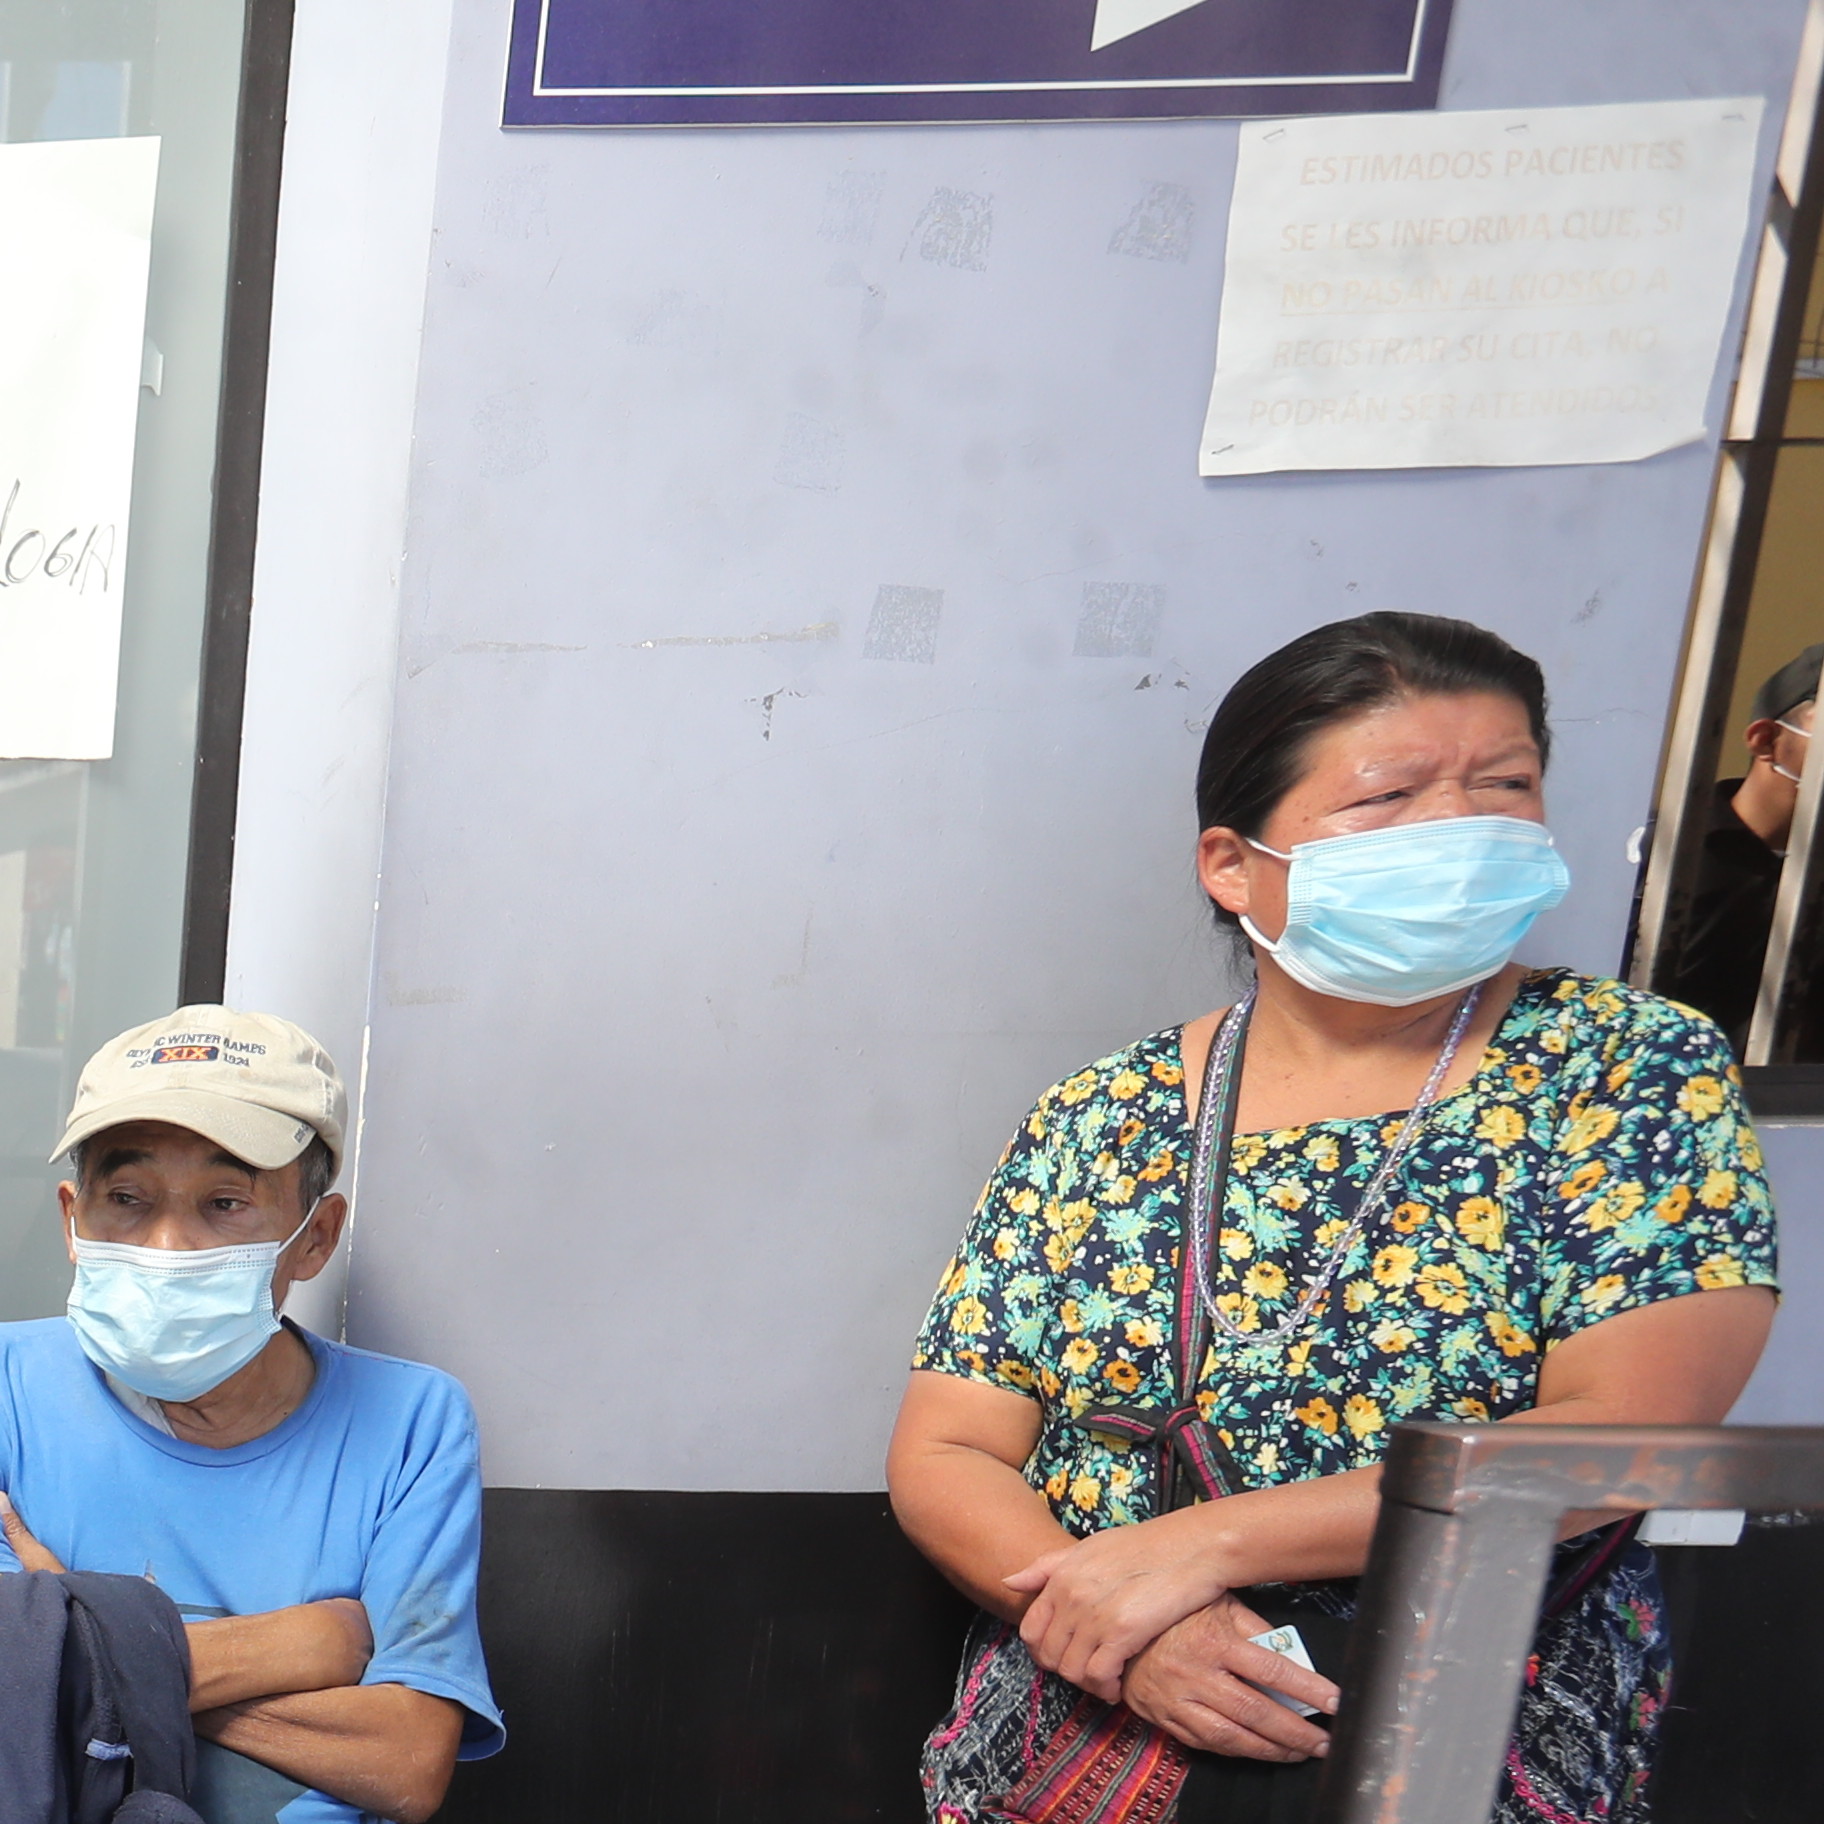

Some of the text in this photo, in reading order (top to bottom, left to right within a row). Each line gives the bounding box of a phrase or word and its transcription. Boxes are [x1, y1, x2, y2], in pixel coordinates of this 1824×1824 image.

[1299, 139, 1688, 187] ESTIMADOS PACIENTES
[1279, 204, 1685, 253] SE LES INFORMA QUE, SI
[1280, 266, 1670, 312] NO PASAN AL KIOSKO A
[1272, 335, 1451, 369] REGISTRAR
[1458, 332, 1499, 363] SU
[1605, 325, 1660, 356] NO
[1247, 389, 1390, 429] PODRÁN
[1397, 391, 1457, 423] SER
[159, 1047, 211, 1062] XIX
[169, 1034, 221, 1045] WINTER
[223, 1038, 266, 1055] GAMES
[223, 1053, 249, 1067] 1924
